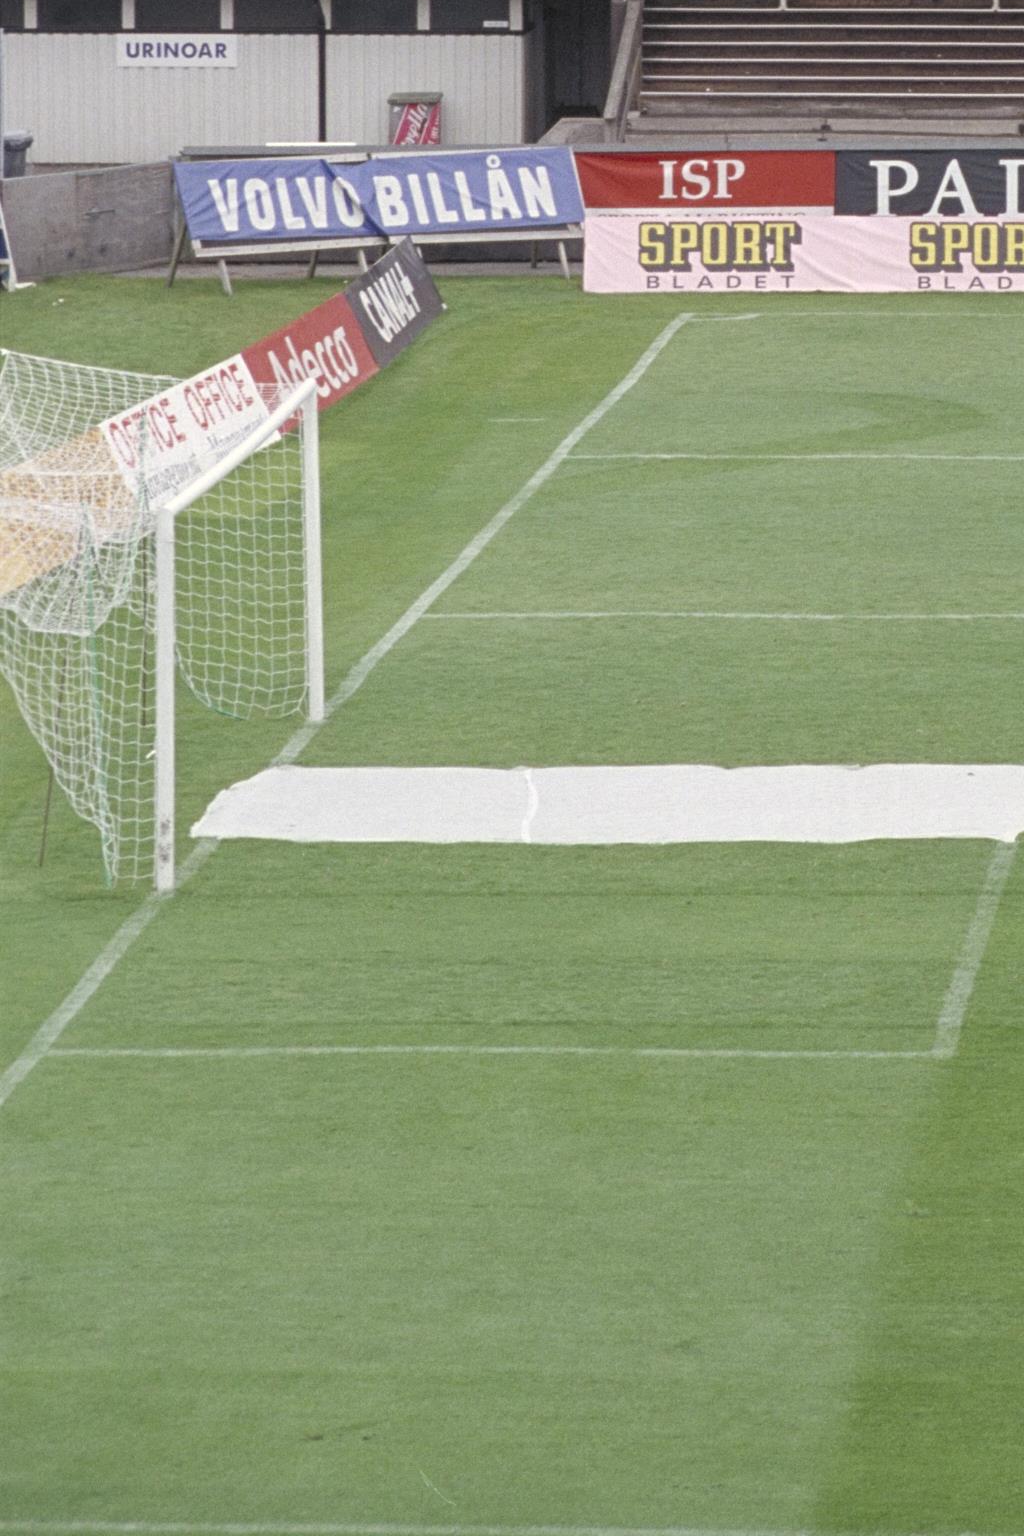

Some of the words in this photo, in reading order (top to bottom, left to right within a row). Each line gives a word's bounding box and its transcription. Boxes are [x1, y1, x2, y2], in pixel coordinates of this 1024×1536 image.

[125, 41, 228, 60] URINOAR
[207, 177, 366, 232] VOLVO
[373, 154, 556, 227] BILLÅN
[658, 158, 746, 200] ISP
[638, 221, 802, 273] SPORT
[646, 274, 796, 289] BLADET
[267, 324, 360, 401] Adecco
[182, 362, 255, 432] OFFICE
